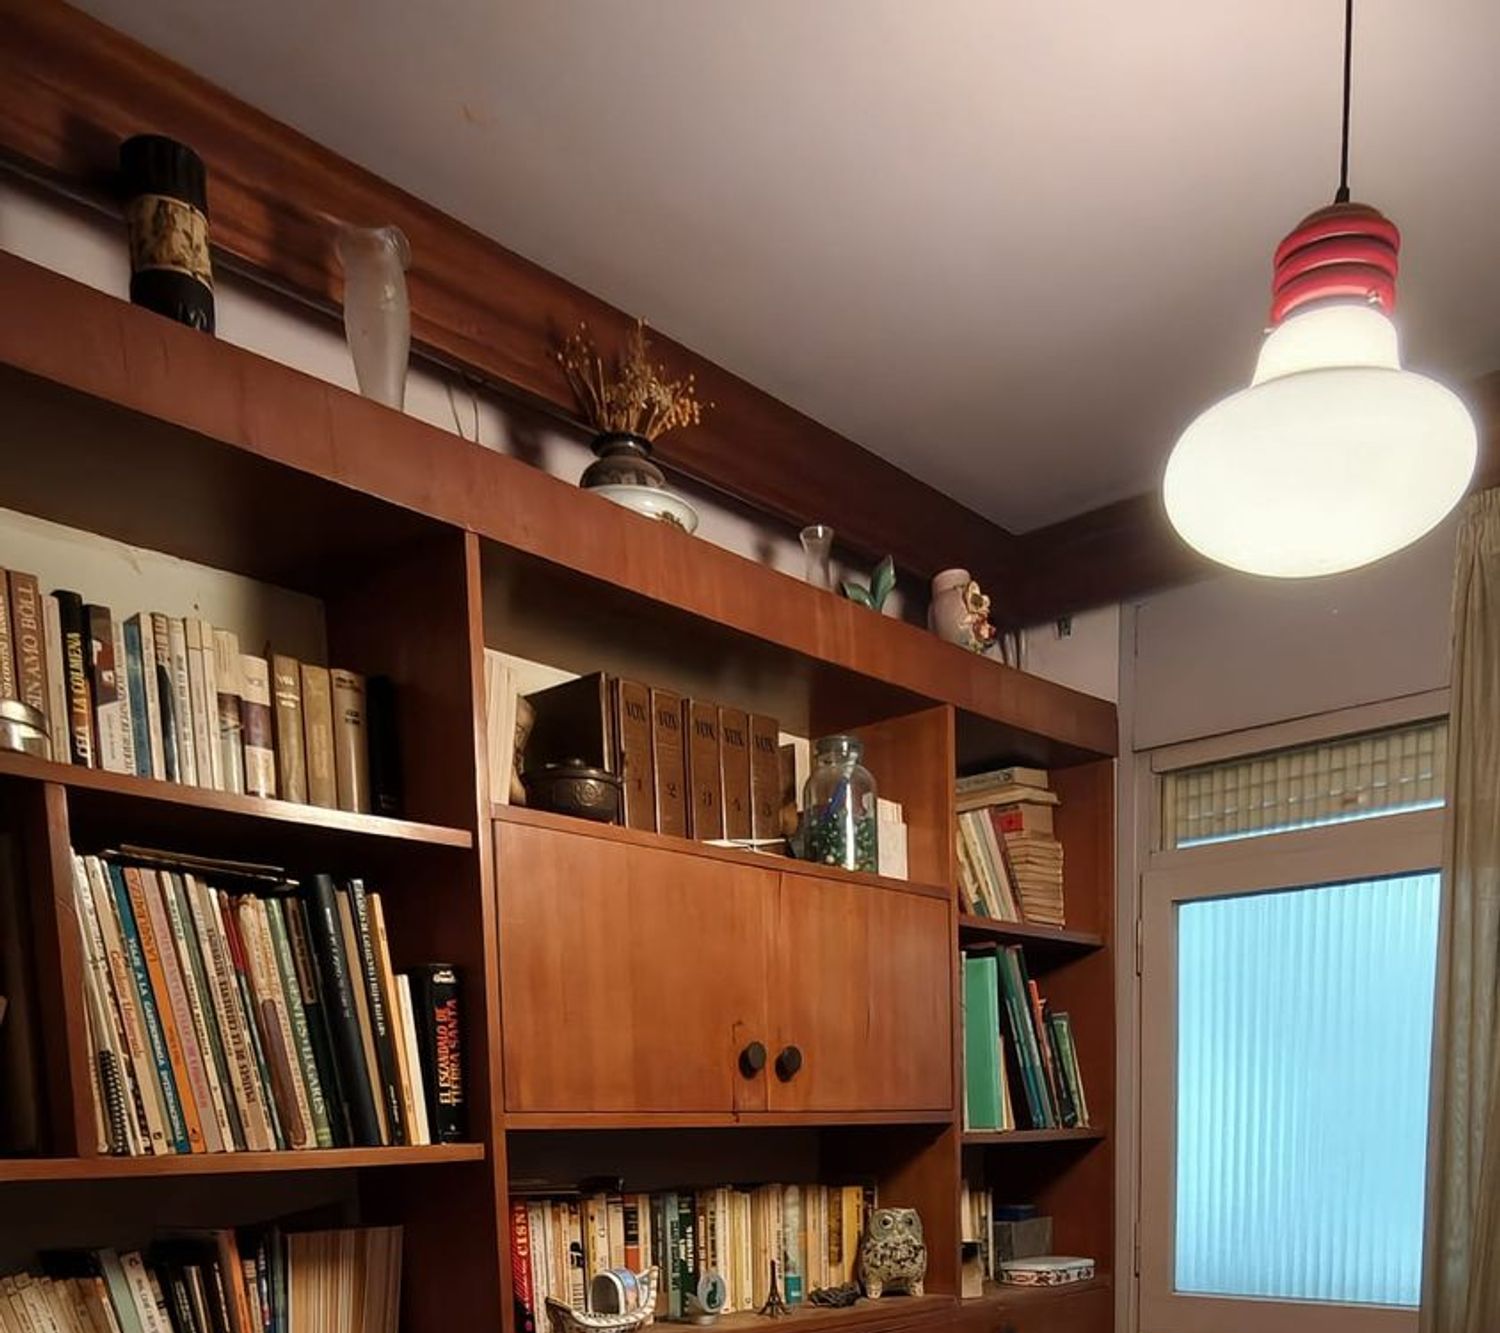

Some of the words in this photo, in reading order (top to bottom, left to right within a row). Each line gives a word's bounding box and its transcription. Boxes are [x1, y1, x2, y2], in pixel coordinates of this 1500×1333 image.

[66, 632, 85, 694] COLMENA
[72, 697, 88, 714] LA
[75, 726, 90, 759] CELA
[139, 982, 149, 996] LA
[288, 976, 308, 1037] GENTES
[435, 1006, 448, 1023] DE
[446, 999, 461, 1048] SANTA
[449, 1052, 464, 1106] TIERRA
[439, 1092, 451, 1105] EL
